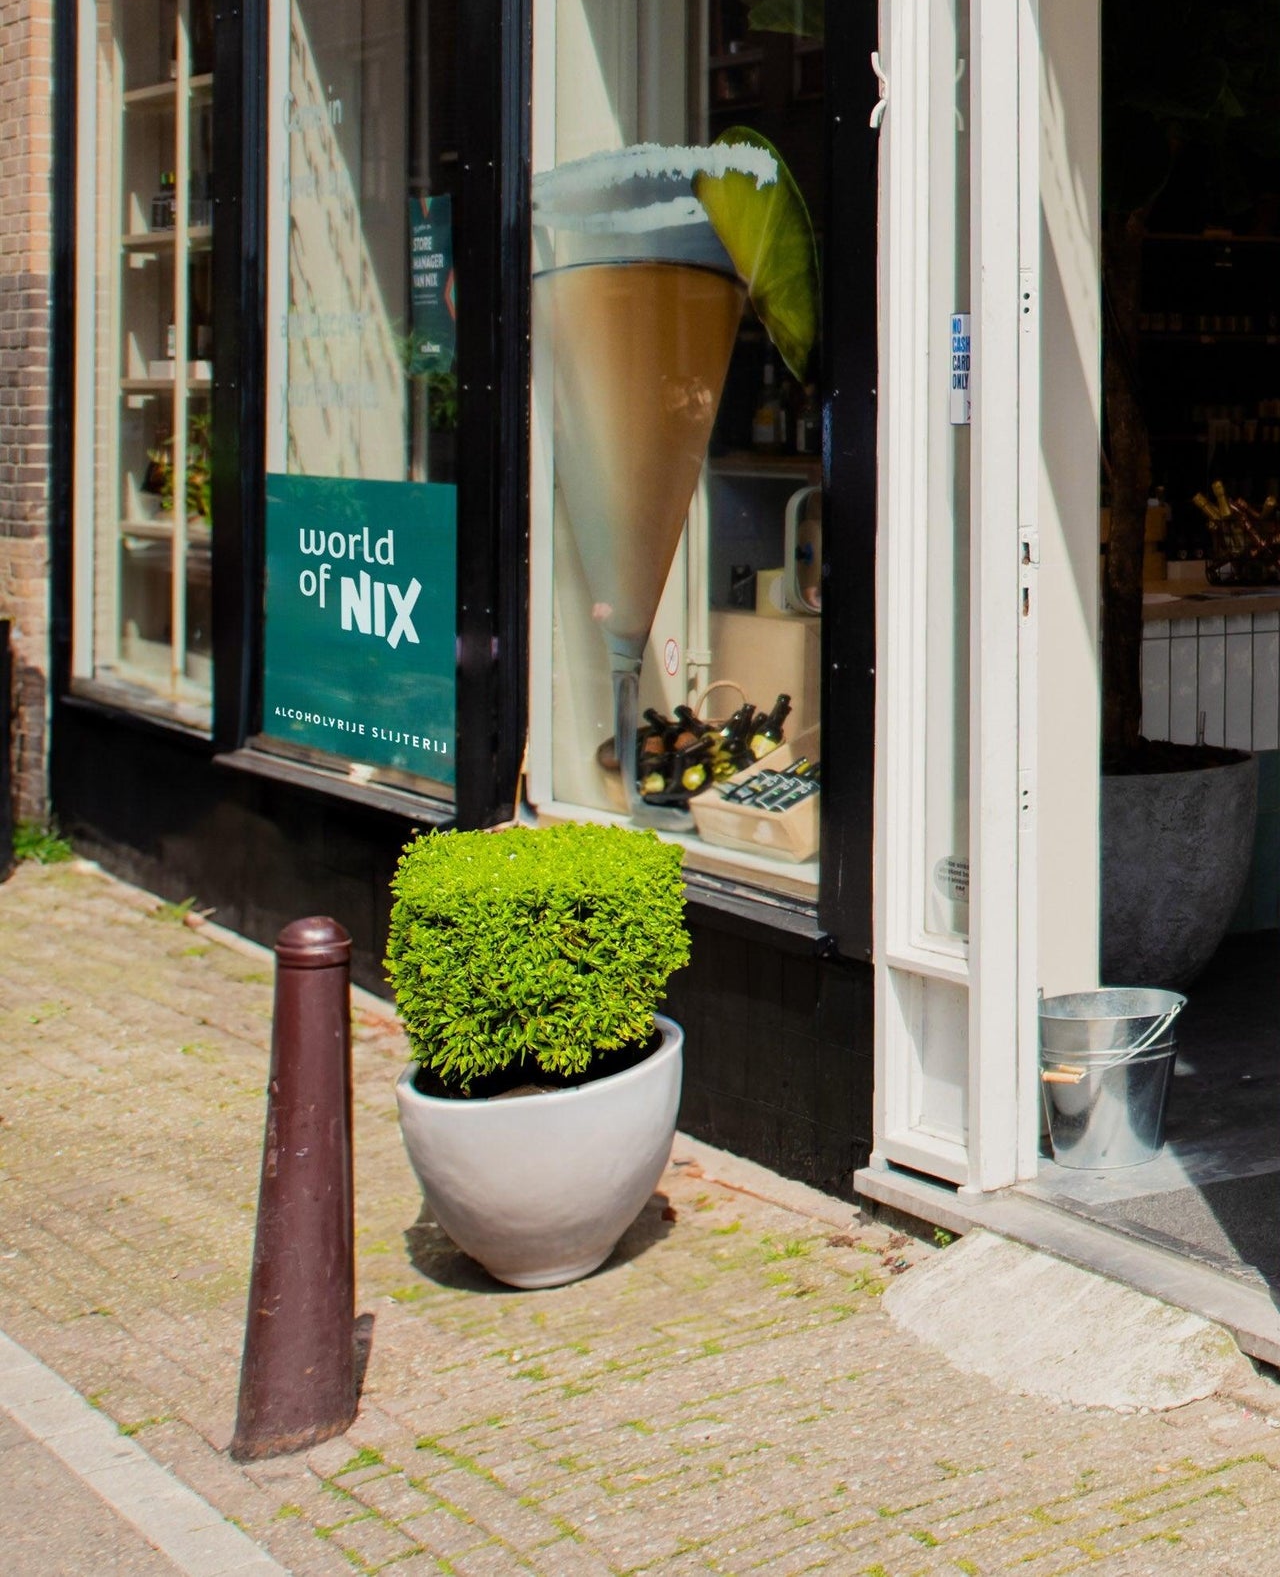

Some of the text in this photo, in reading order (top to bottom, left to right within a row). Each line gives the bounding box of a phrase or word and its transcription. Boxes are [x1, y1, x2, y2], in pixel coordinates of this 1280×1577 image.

[328, 85, 342, 125] in
[952, 317, 962, 335] NO
[952, 335, 970, 353] CASH
[952, 354, 970, 371] CARD
[952, 373, 969, 390] ONLY
[299, 526, 395, 566] world
[299, 563, 422, 650] of NIX
[274, 706, 448, 754] ALCOHOLVRIJE SLIJTERIJ
